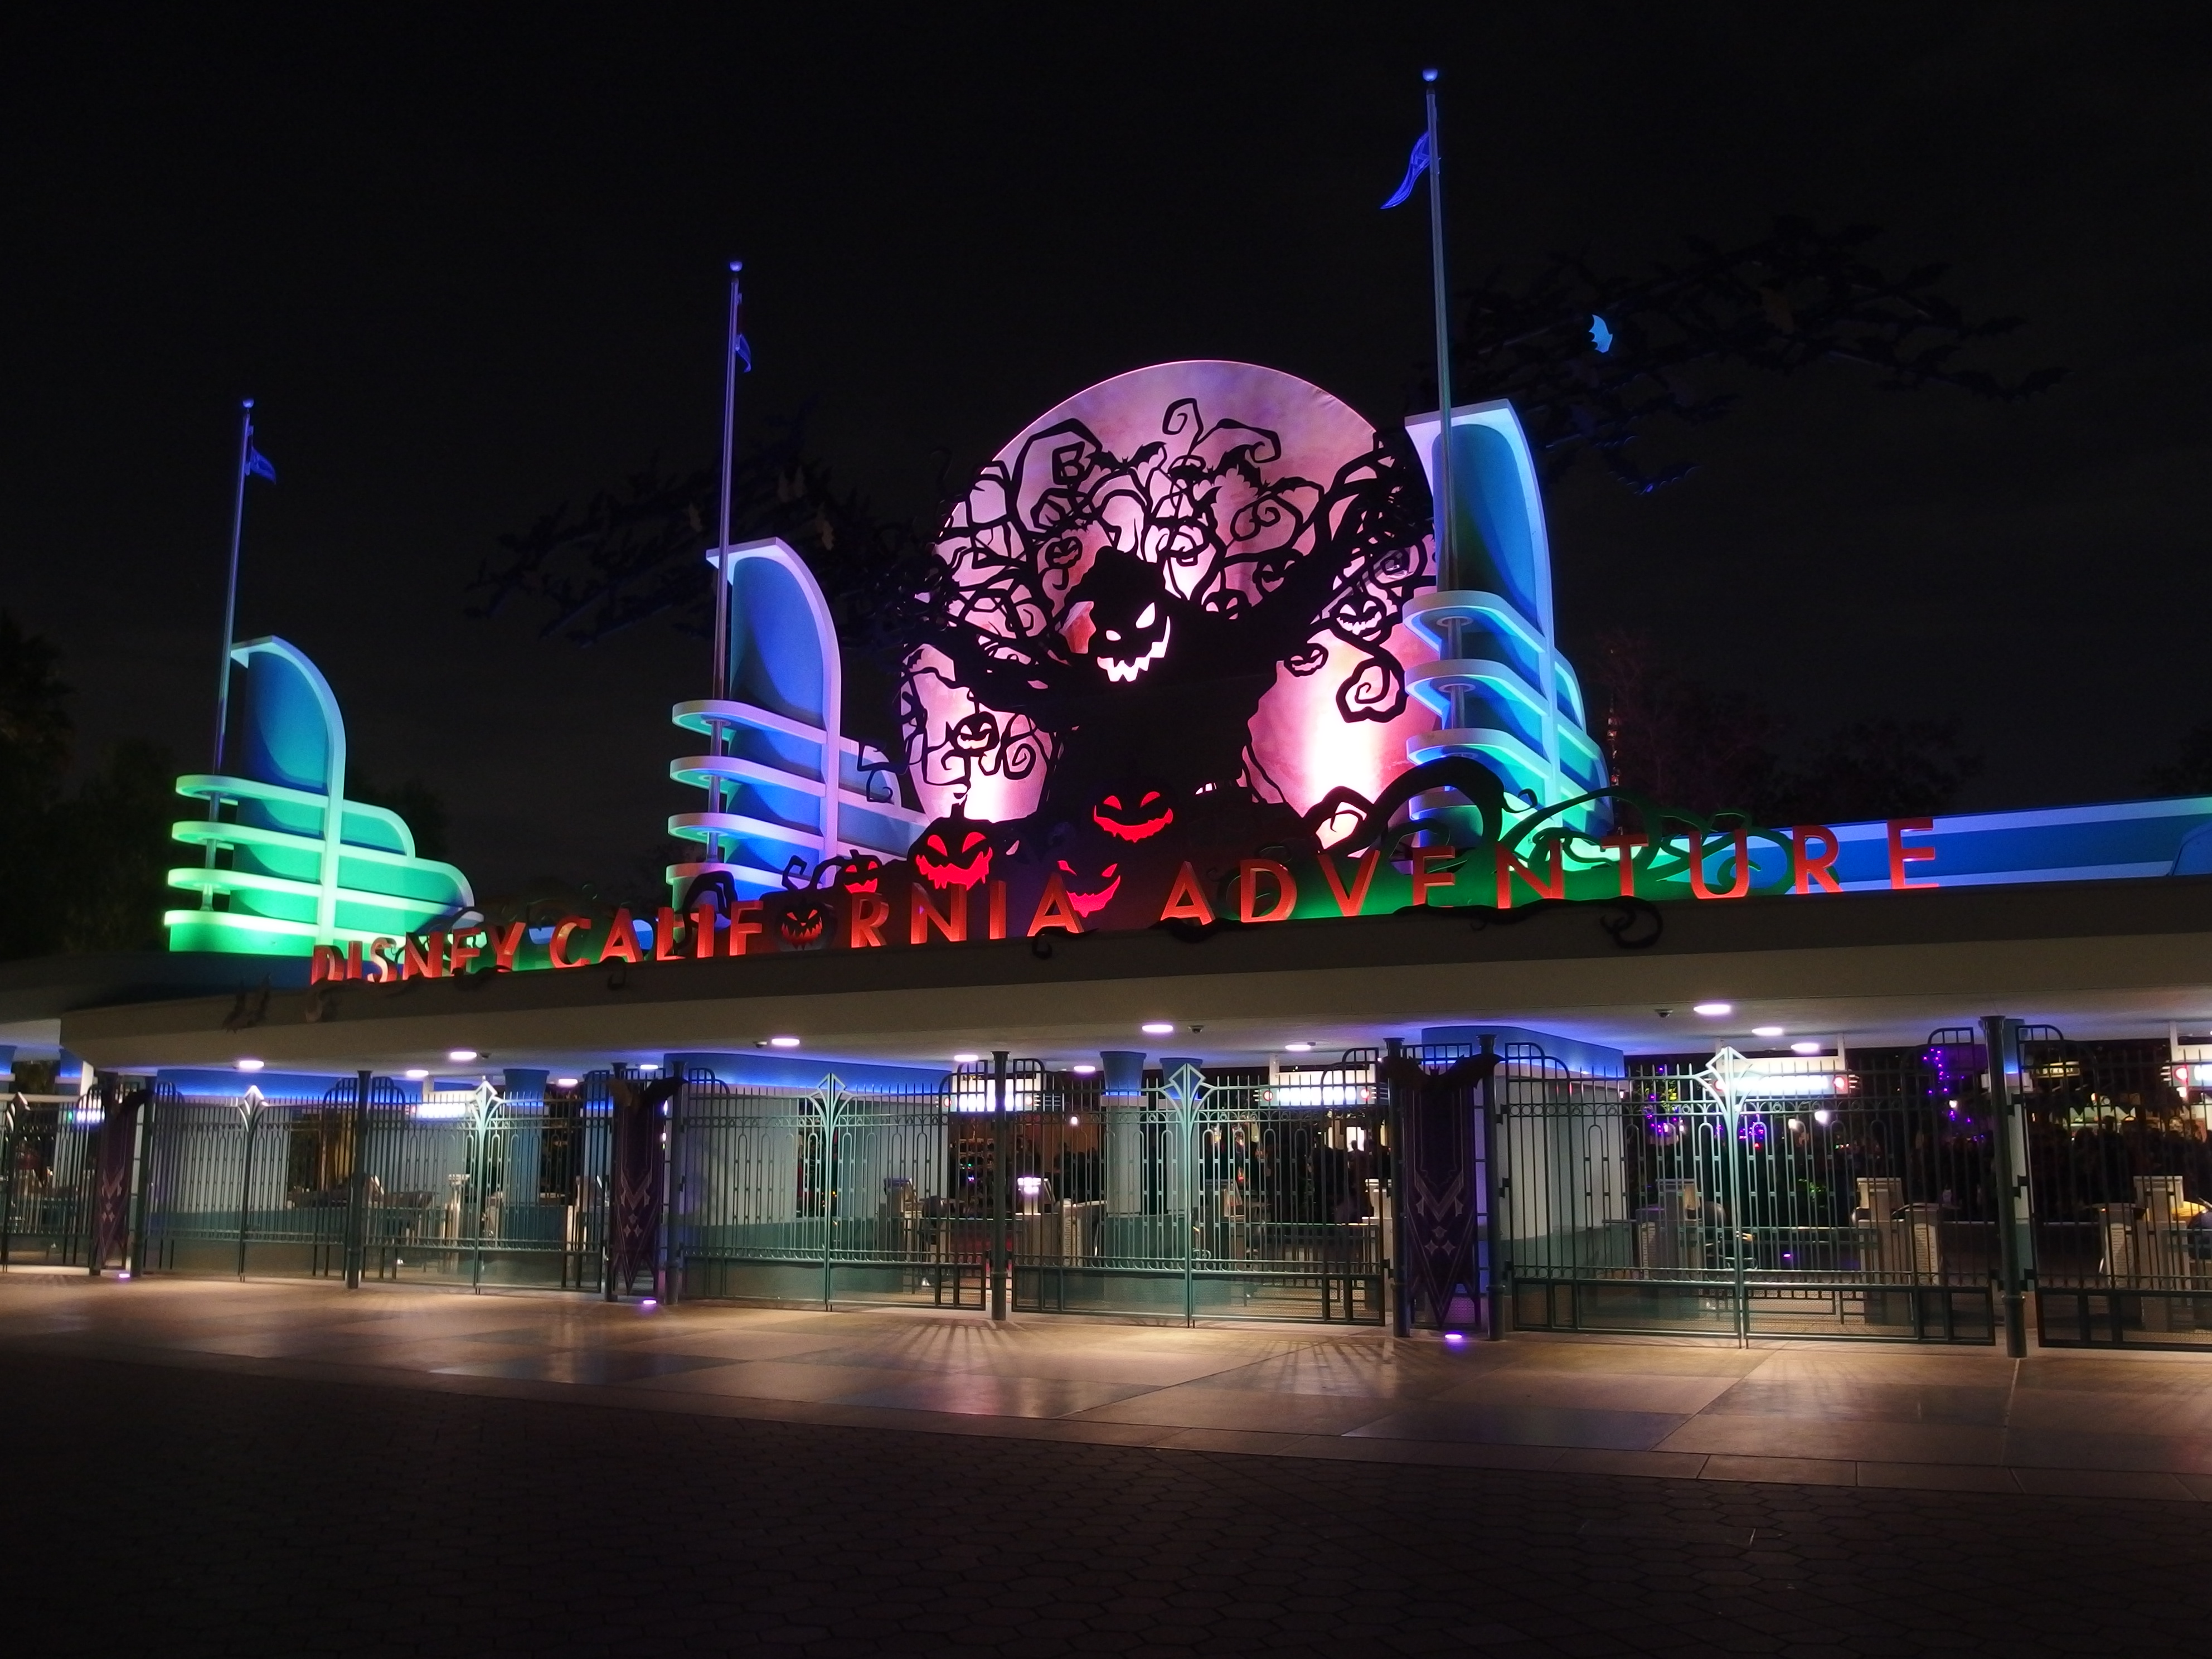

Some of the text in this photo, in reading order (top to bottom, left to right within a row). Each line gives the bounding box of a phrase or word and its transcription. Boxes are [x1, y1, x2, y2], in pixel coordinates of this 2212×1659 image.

[311, 817, 1942, 985] DISNEY CALIFRNIA ADVENTURE
